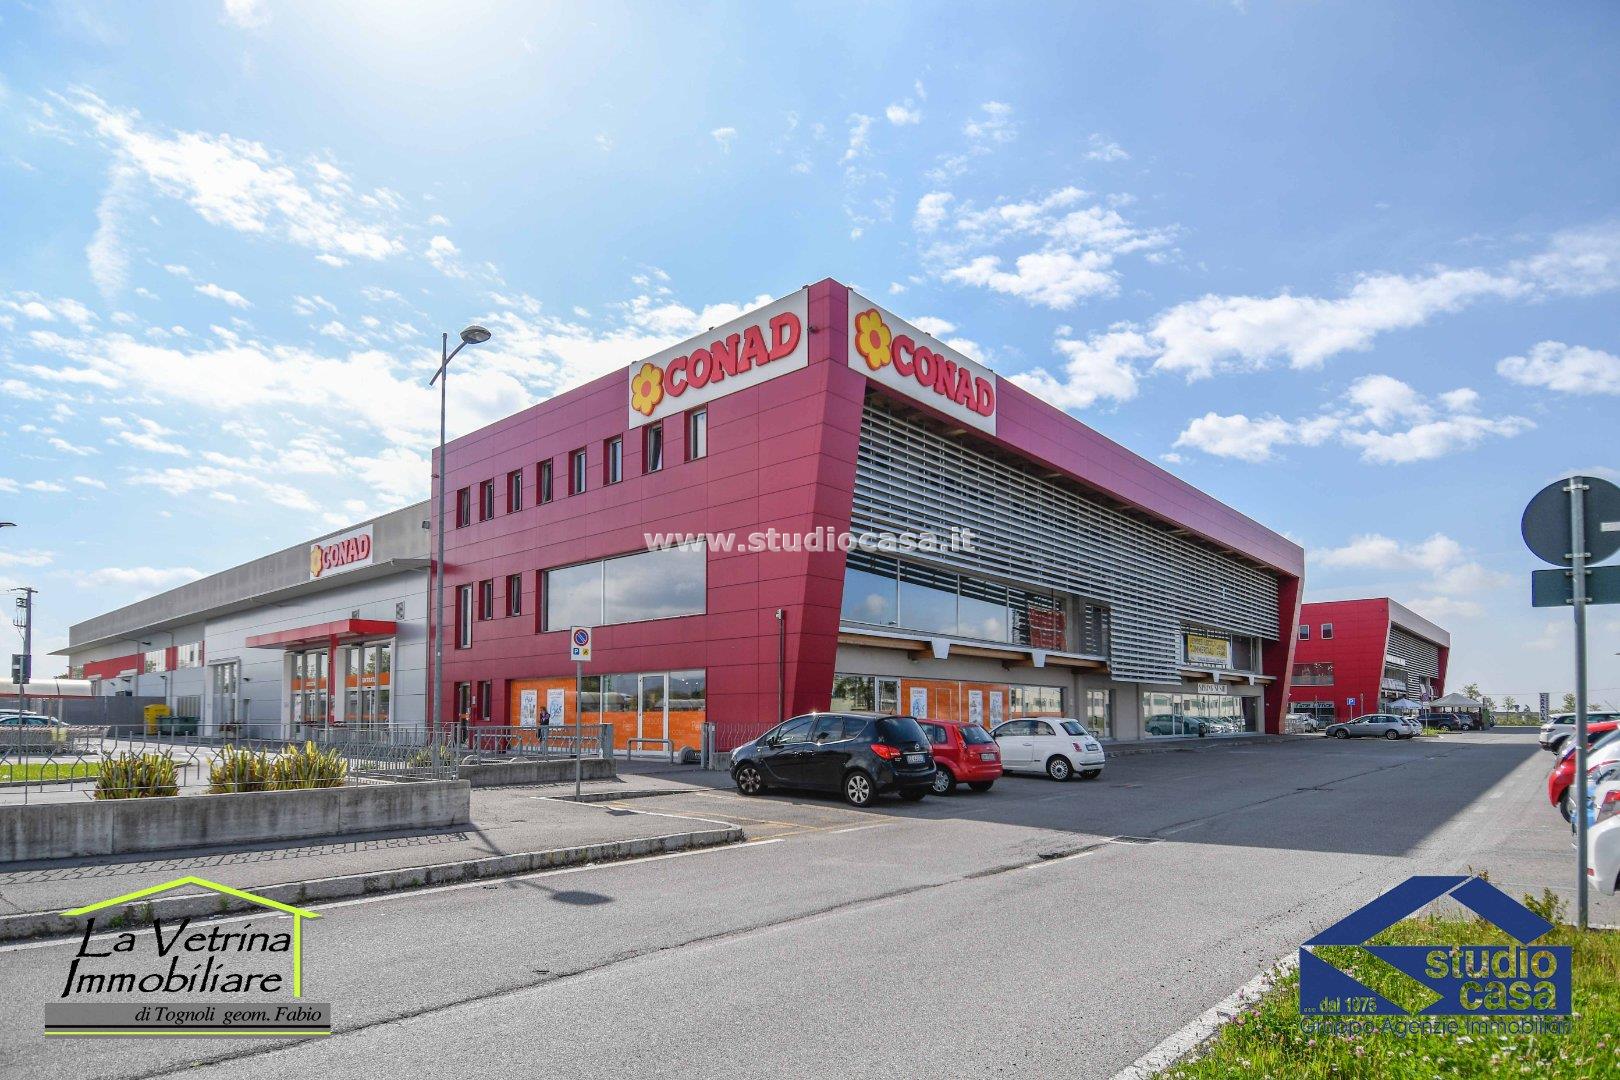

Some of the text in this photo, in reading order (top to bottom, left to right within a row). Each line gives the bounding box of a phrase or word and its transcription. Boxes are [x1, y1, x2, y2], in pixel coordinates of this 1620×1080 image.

[664, 311, 802, 397] CONAD
[891, 334, 995, 417] CONAD
[322, 534, 371, 569] CONAD
